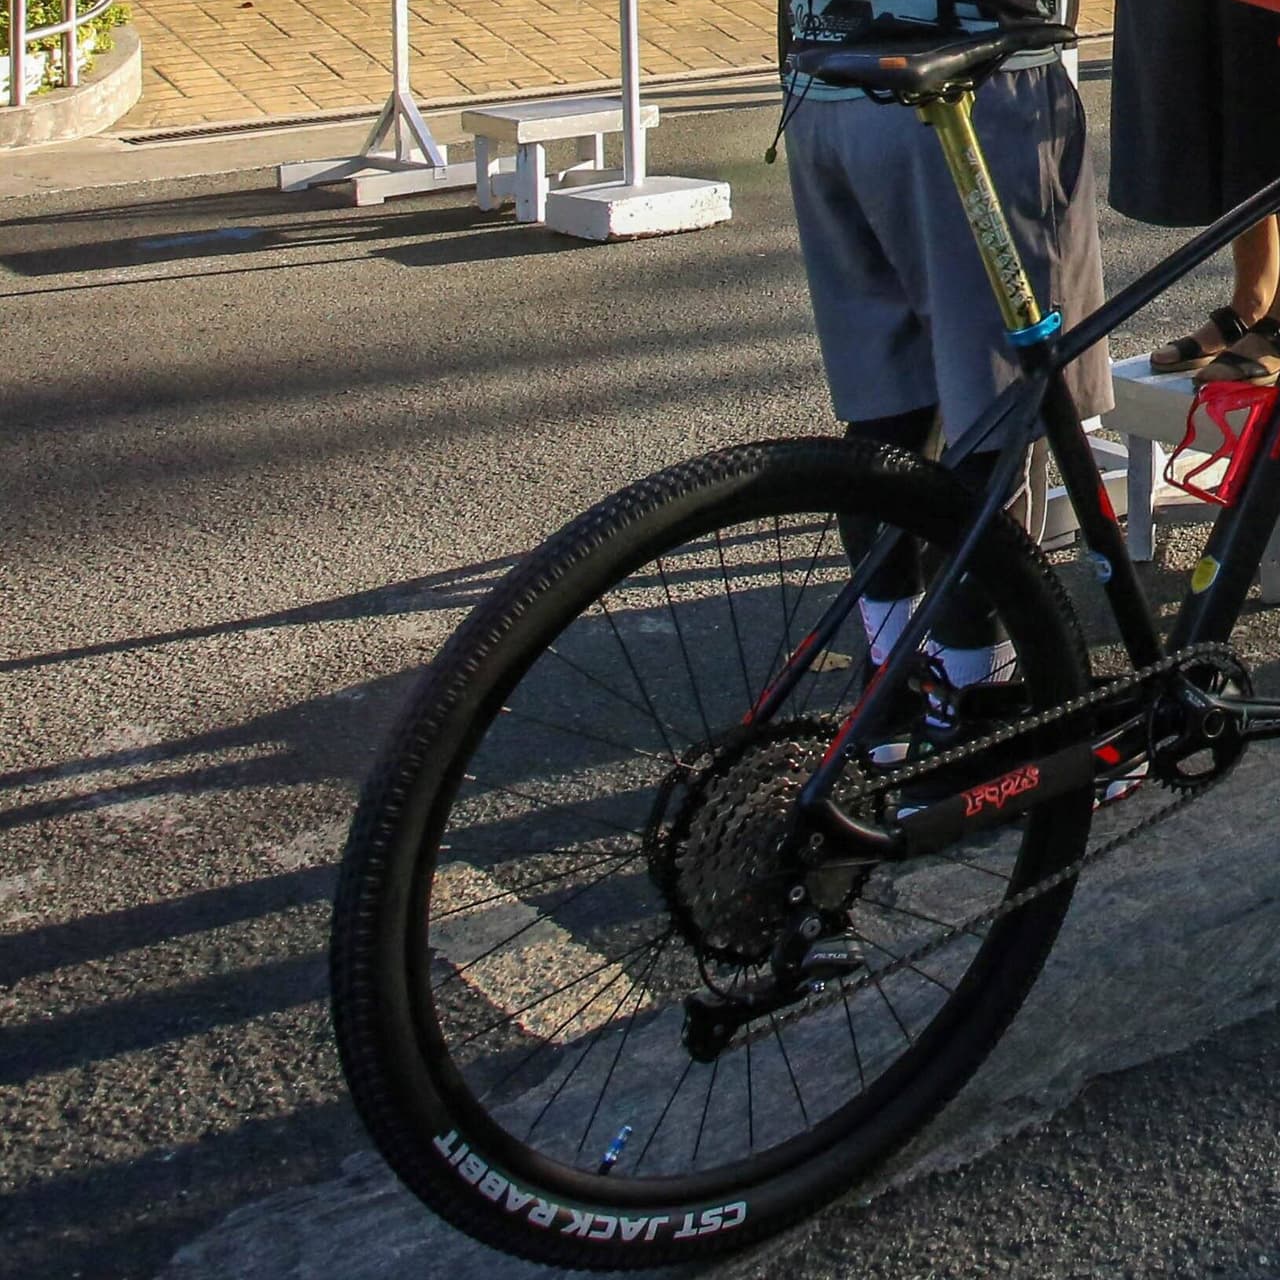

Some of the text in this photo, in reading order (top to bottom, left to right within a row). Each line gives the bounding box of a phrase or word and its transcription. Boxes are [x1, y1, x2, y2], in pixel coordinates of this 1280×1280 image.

[432, 1128, 747, 1241] CST JACK RABBIT
